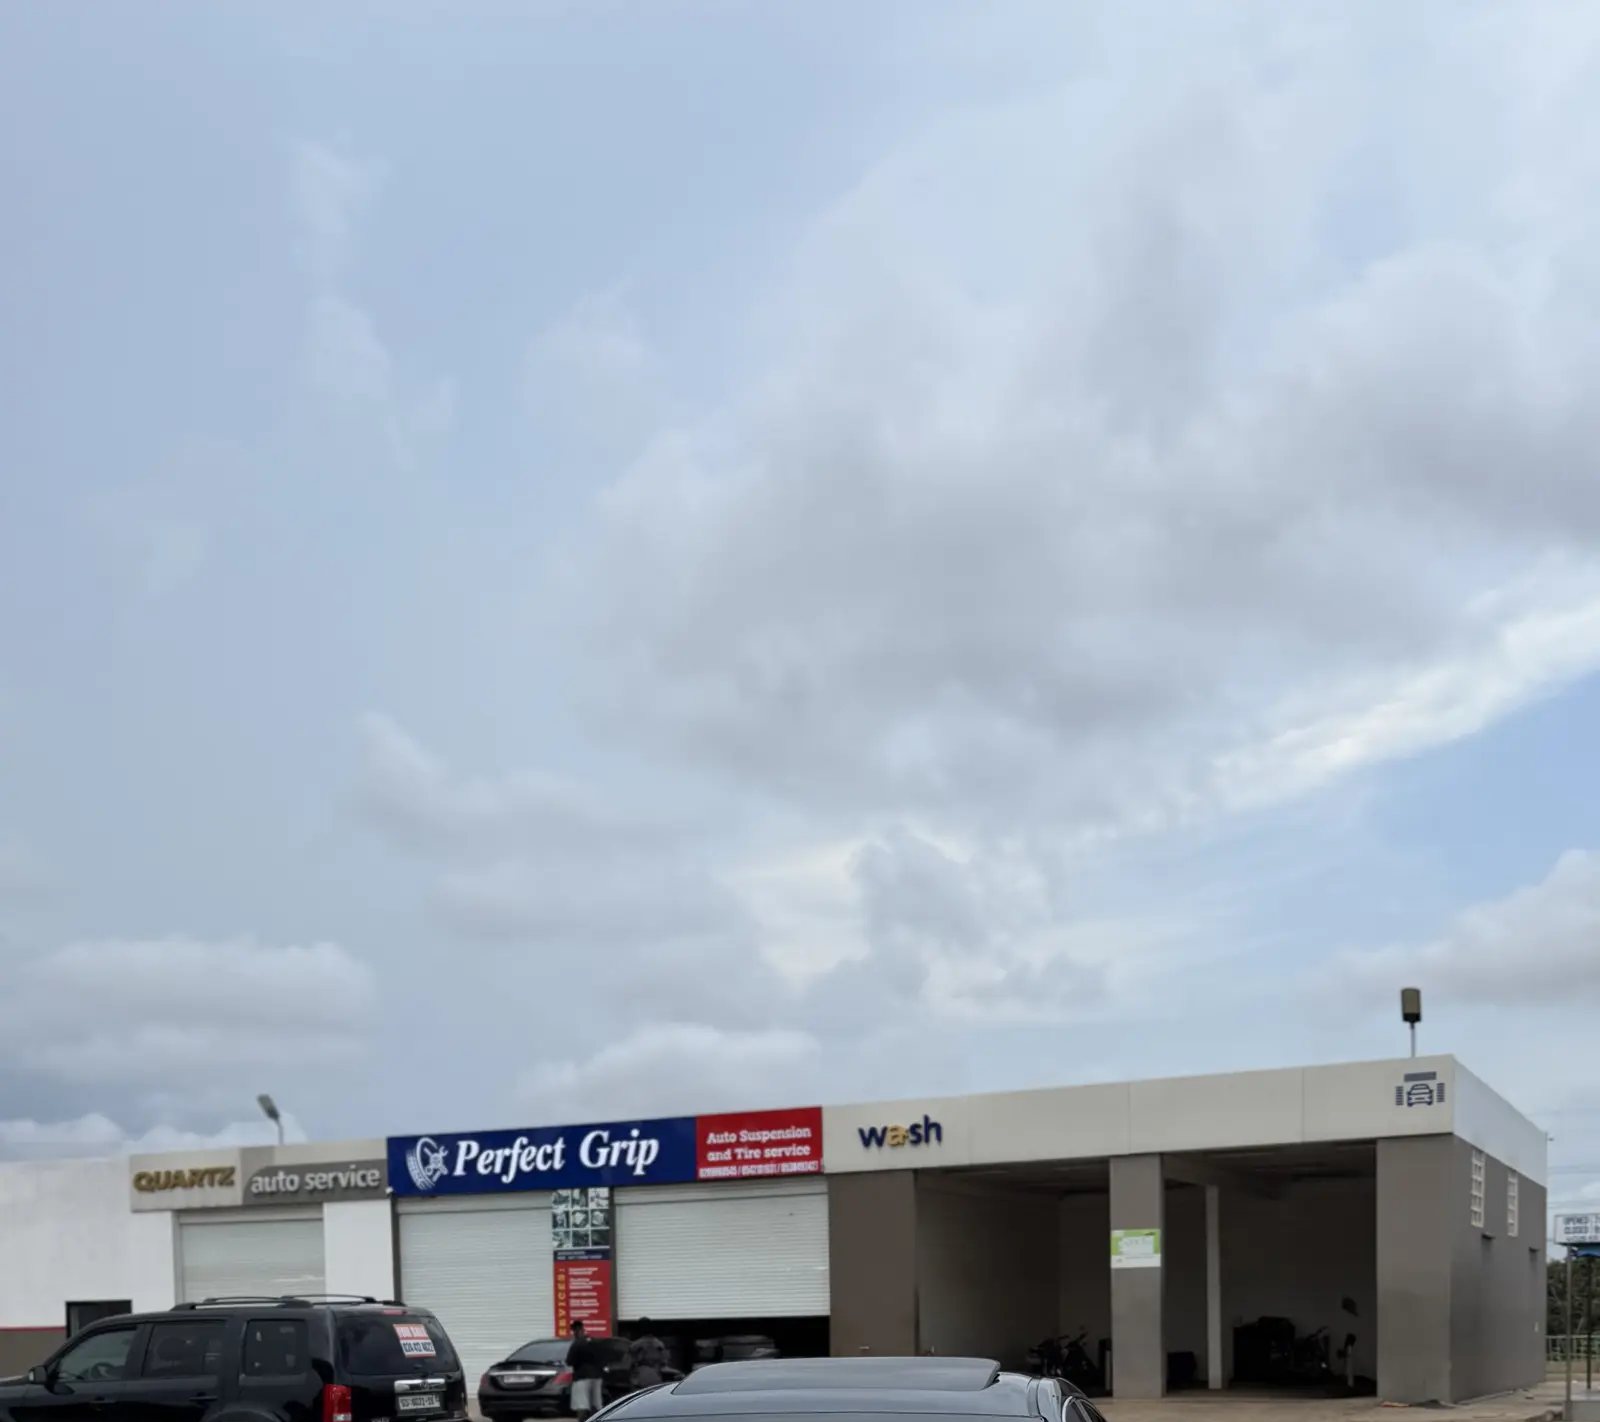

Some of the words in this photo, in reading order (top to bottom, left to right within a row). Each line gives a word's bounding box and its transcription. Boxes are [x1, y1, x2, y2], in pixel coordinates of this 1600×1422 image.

[706, 1130, 737, 1145] Auto
[739, 1125, 812, 1144] Suspension
[858, 1114, 942, 1149] wash
[452, 1136, 566, 1184] Perfect
[578, 1128, 659, 1176] Grip
[707, 1149, 732, 1162] and
[734, 1146, 761, 1160] Tire
[764, 1143, 811, 1158] service
[133, 1166, 236, 1193] QUARTZ
[250, 1169, 300, 1194] auto
[304, 1164, 381, 1190] service
